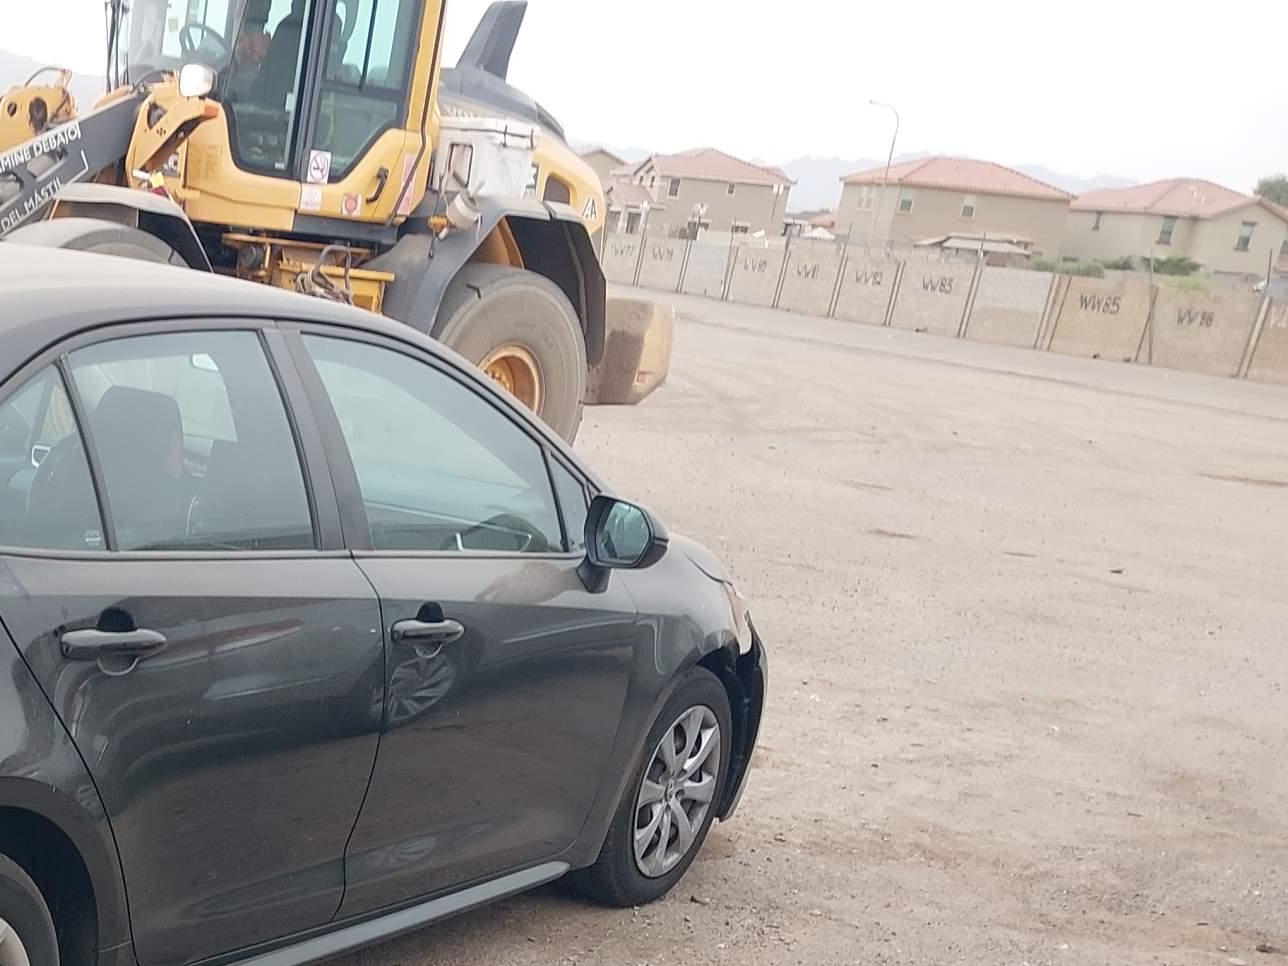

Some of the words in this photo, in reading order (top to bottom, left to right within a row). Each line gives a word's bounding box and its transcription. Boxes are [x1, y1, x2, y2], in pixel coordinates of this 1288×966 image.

[33, 126, 76, 157] DEBAJO
[0, 209, 24, 232] DEL
[1079, 293, 1122, 315] WW85
